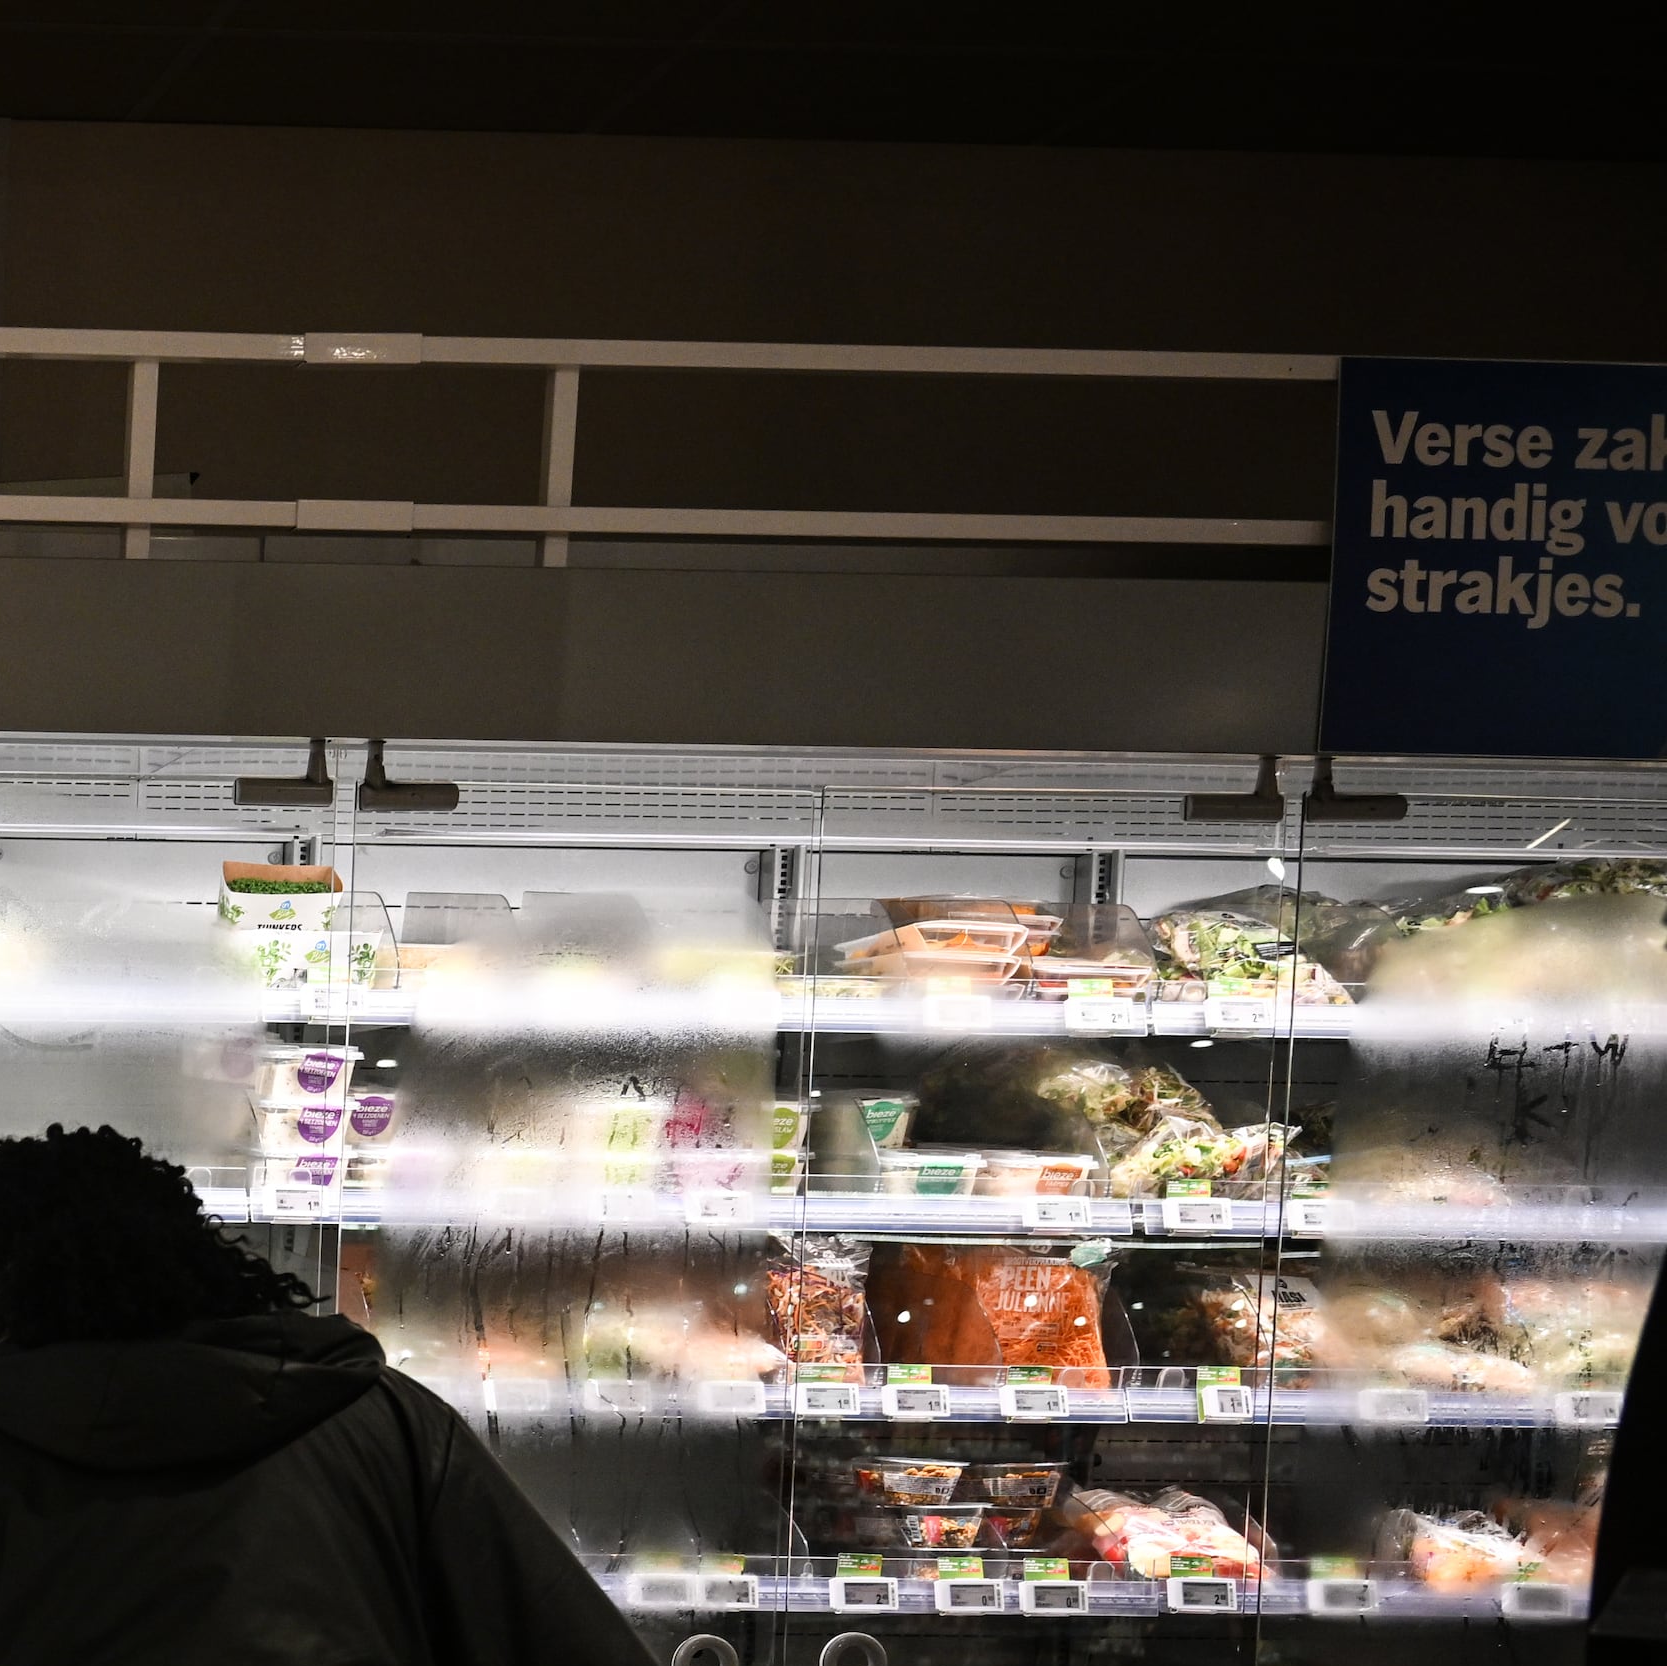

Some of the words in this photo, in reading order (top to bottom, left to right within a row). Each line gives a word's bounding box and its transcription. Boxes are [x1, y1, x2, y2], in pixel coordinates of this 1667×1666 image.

[1372, 410, 1553, 468] Verse
[1370, 479, 1587, 556] handig
[1365, 556, 1640, 629] strakjes.
[304, 1059, 336, 1069] bieze
[303, 1110, 336, 1119] bieze
[866, 1109, 897, 1118] bieze
[922, 1167, 957, 1178] bieze
[1042, 1170, 1075, 1181] bieze
[1000, 1267, 1051, 1290] PEEN
